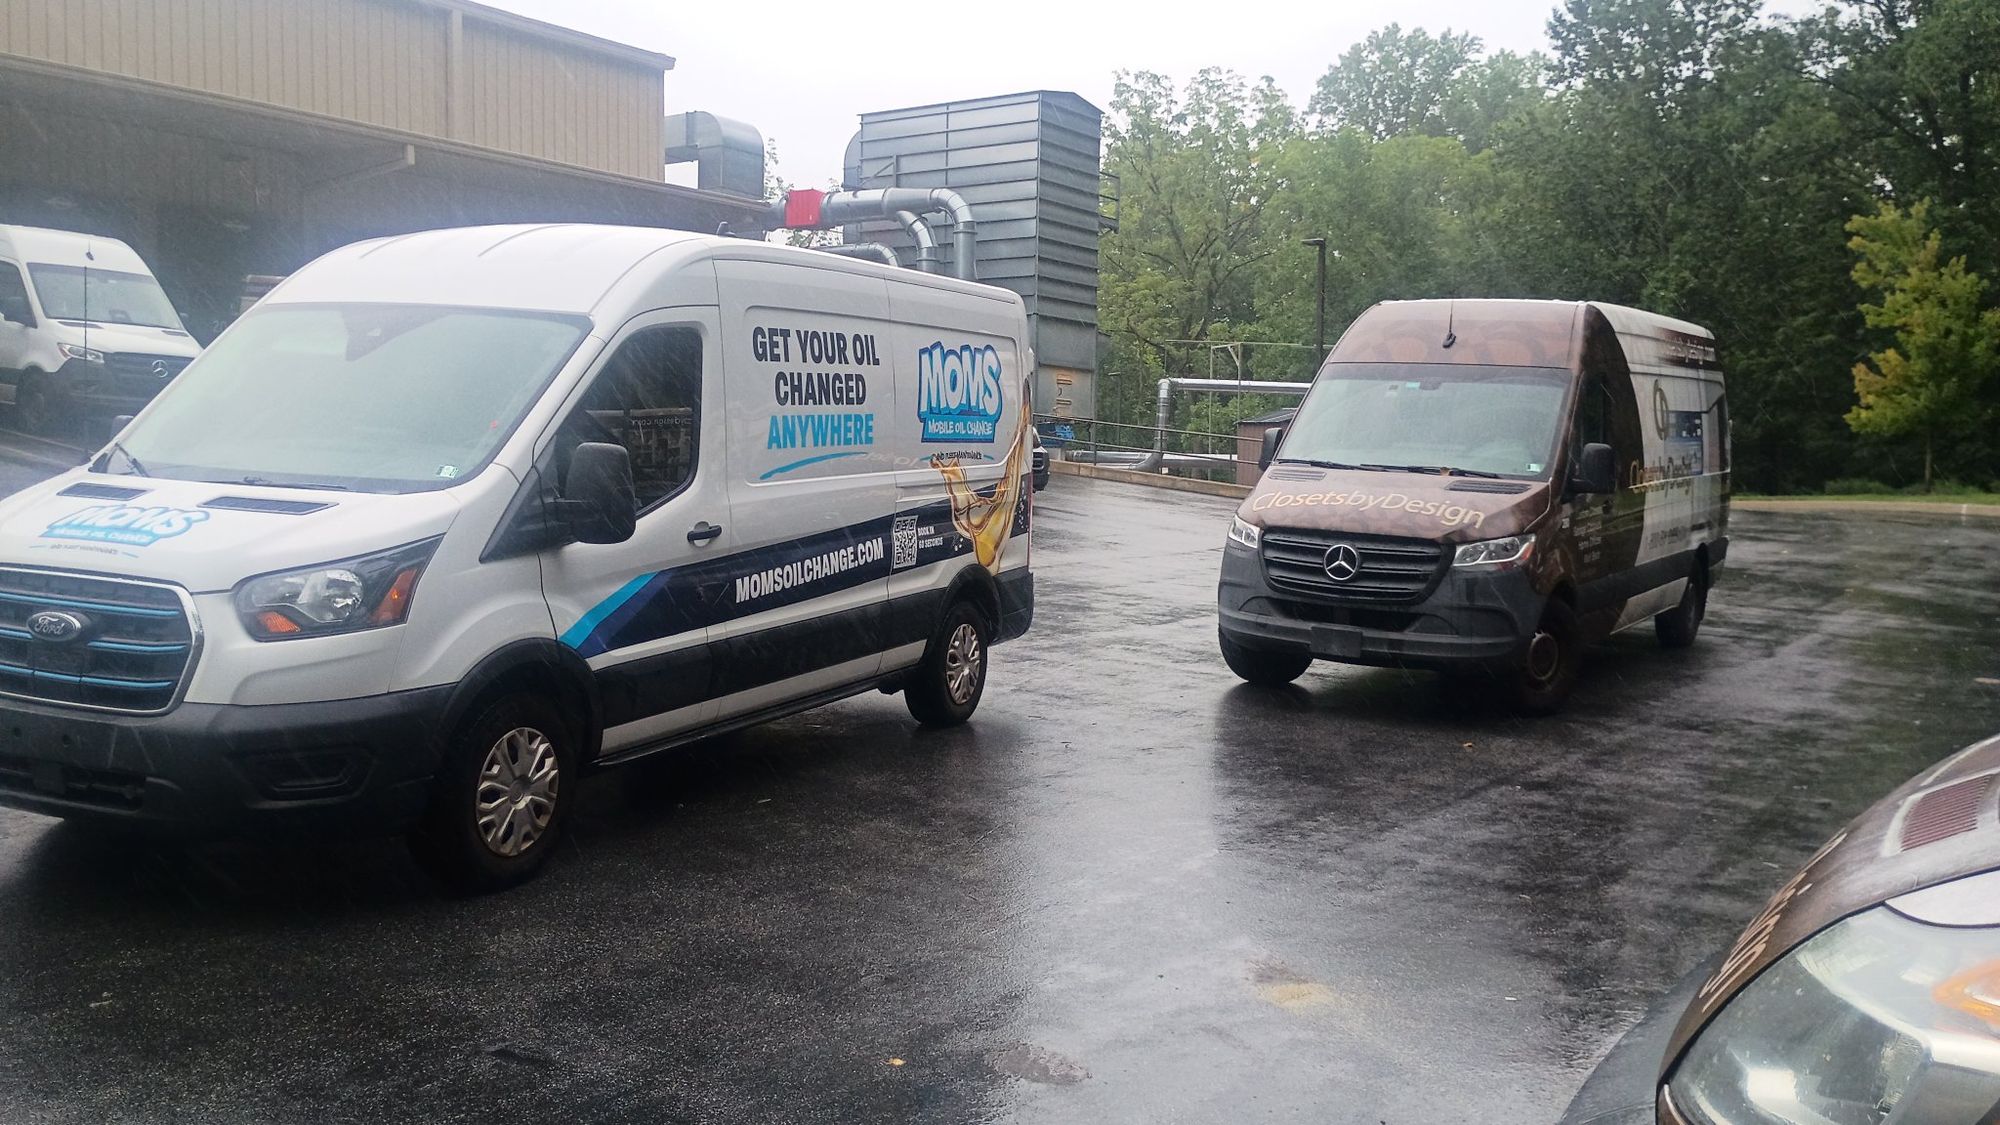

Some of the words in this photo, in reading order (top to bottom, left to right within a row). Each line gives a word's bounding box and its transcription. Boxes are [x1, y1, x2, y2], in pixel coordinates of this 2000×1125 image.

[752, 326, 790, 362] GET
[796, 330, 848, 365] YOUR
[852, 333, 880, 366] OIL
[775, 371, 867, 406] CHANGED
[918, 340, 1002, 417] MOMS
[767, 413, 874, 450] ANYWHERE
[928, 419, 954, 434] MOBILE
[955, 421, 966, 435] OIL
[967, 420, 993, 436] CHANGE
[48, 504, 210, 538] MOMS
[1252, 490, 1486, 529] ClosetsbyDesign
[735, 537, 884, 603] MOMSOILCHANGE.COM
[34, 615, 65, 636] Ford
